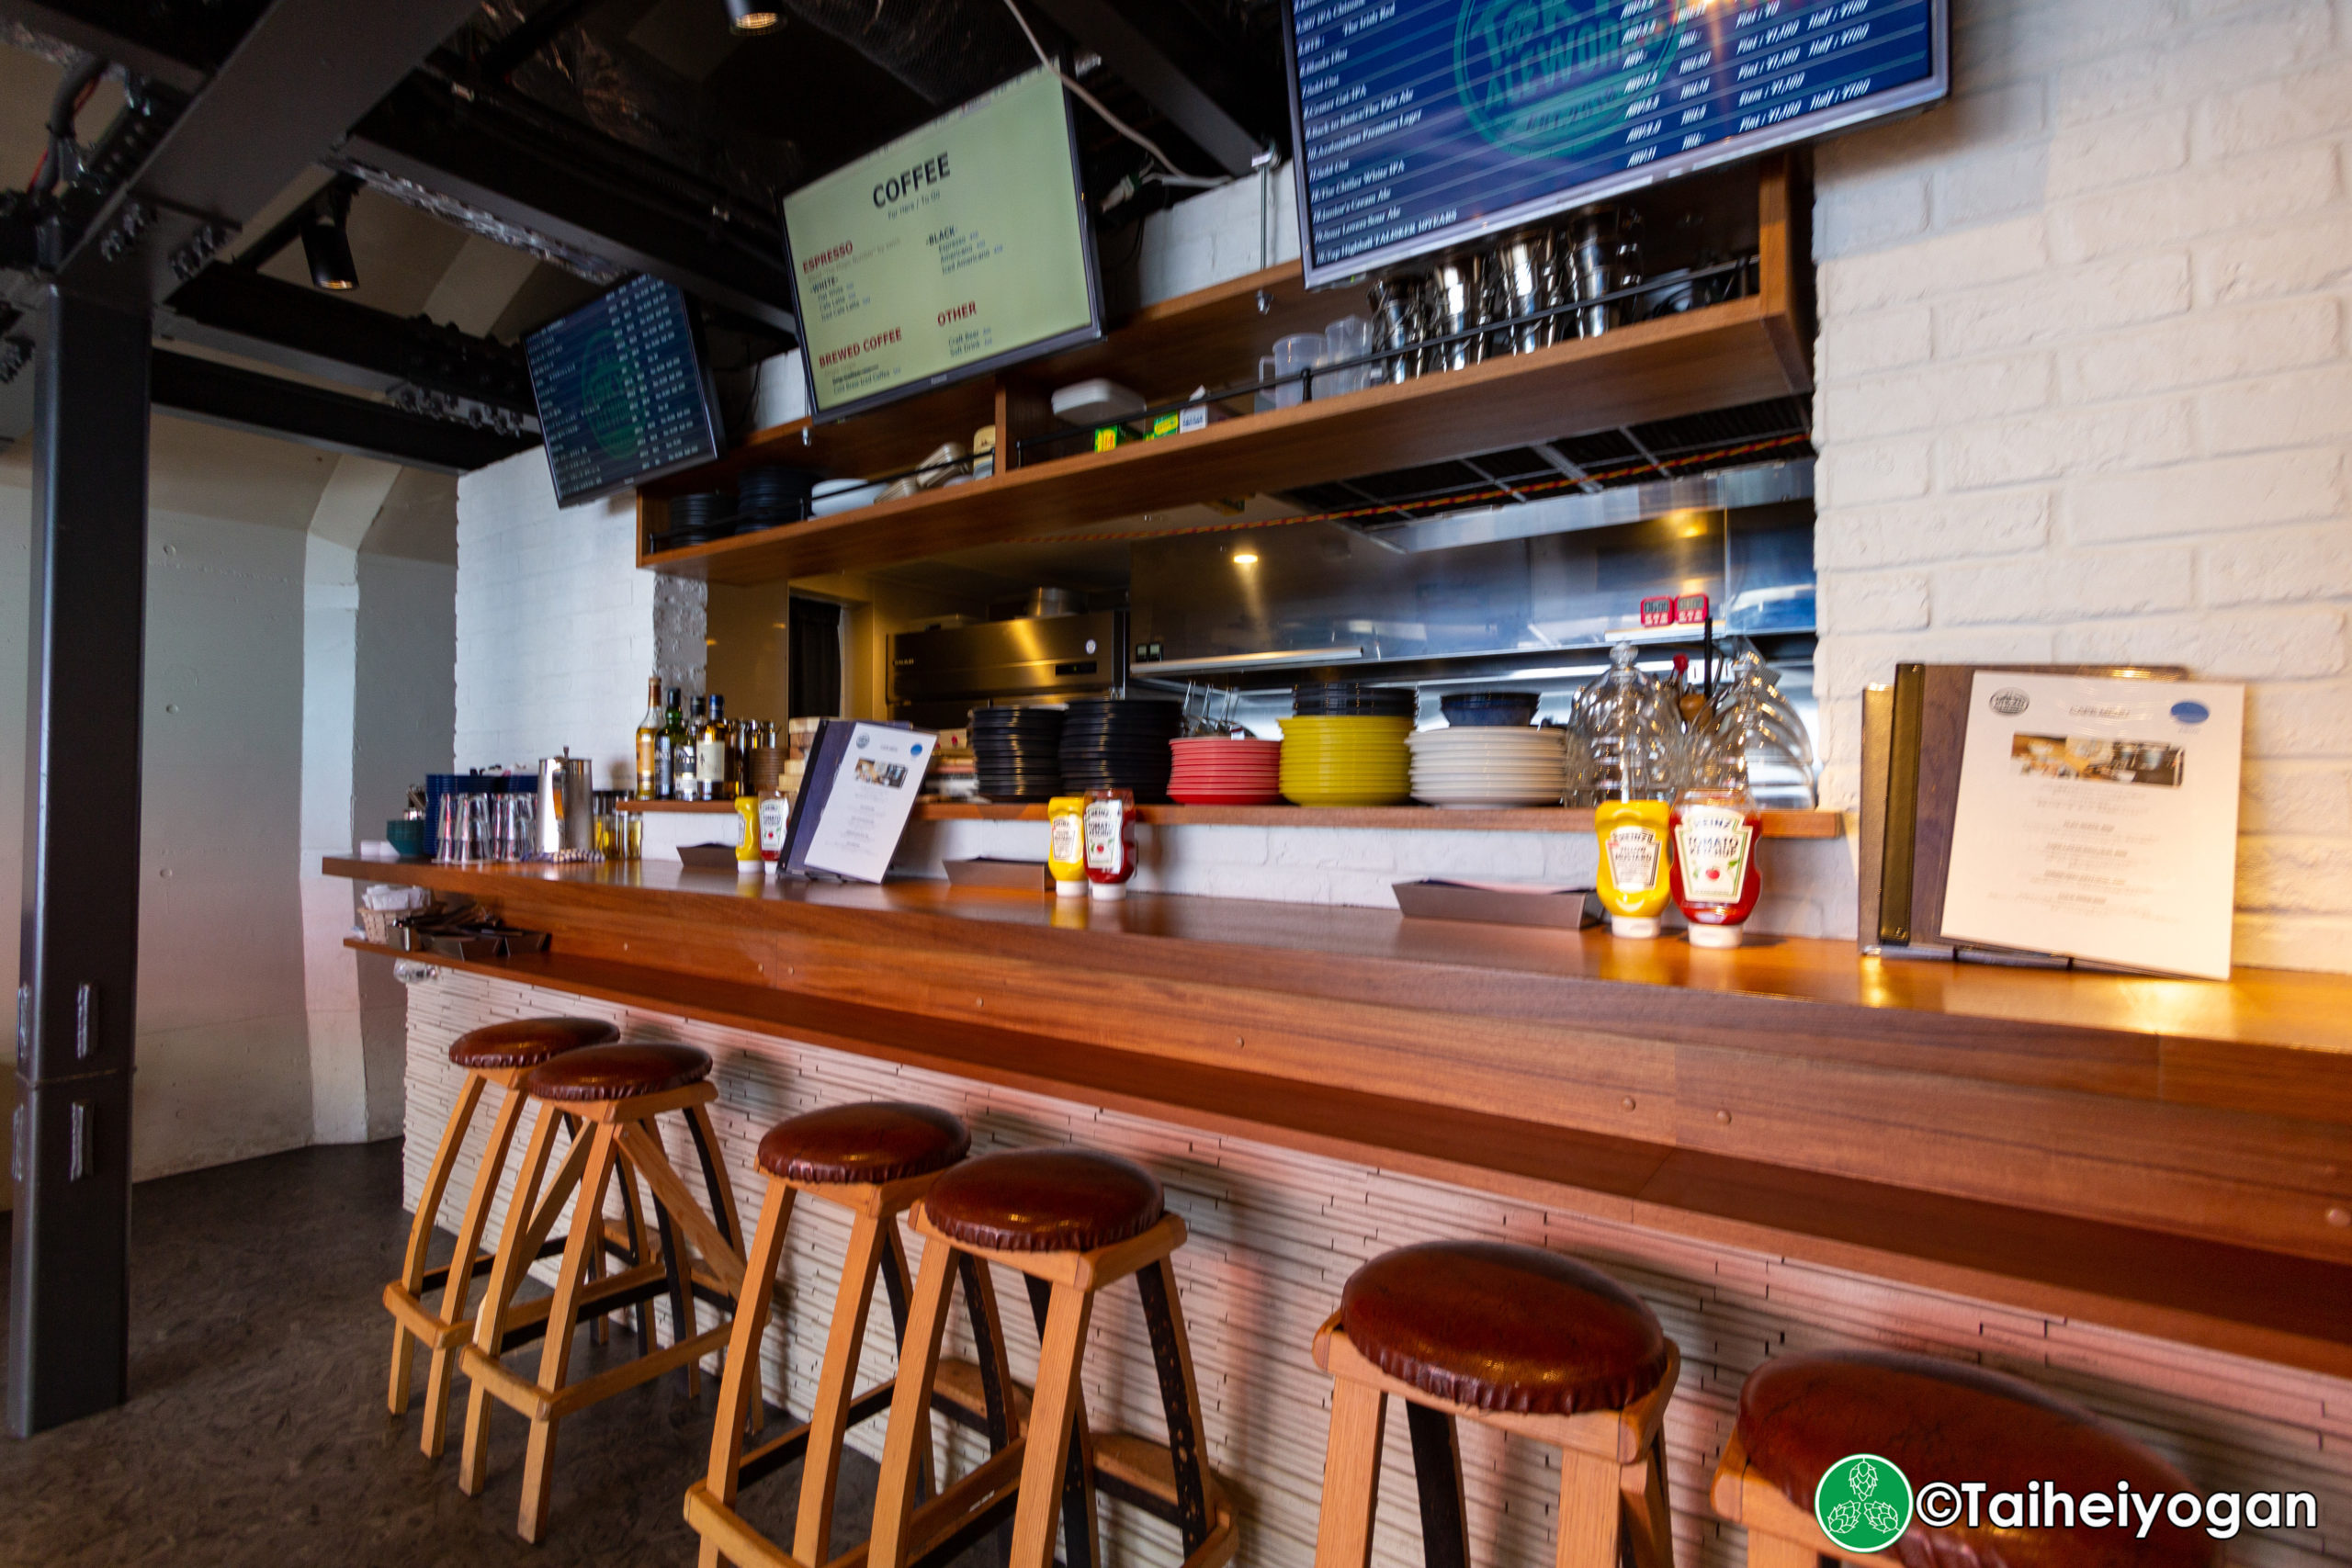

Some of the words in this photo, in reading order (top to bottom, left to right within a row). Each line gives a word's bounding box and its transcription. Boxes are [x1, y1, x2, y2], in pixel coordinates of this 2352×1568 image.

[1807, 6, 1833, 31] Half
[1808, 34, 1834, 58] Half
[1810, 88, 1835, 111] Half
[873, 150, 951, 209] COFFEE
[803, 239, 854, 275] ESPRESSO
[937, 299, 977, 327] OTHER
[819, 342, 861, 369] BREWED
[863, 326, 902, 354] COFFEE
